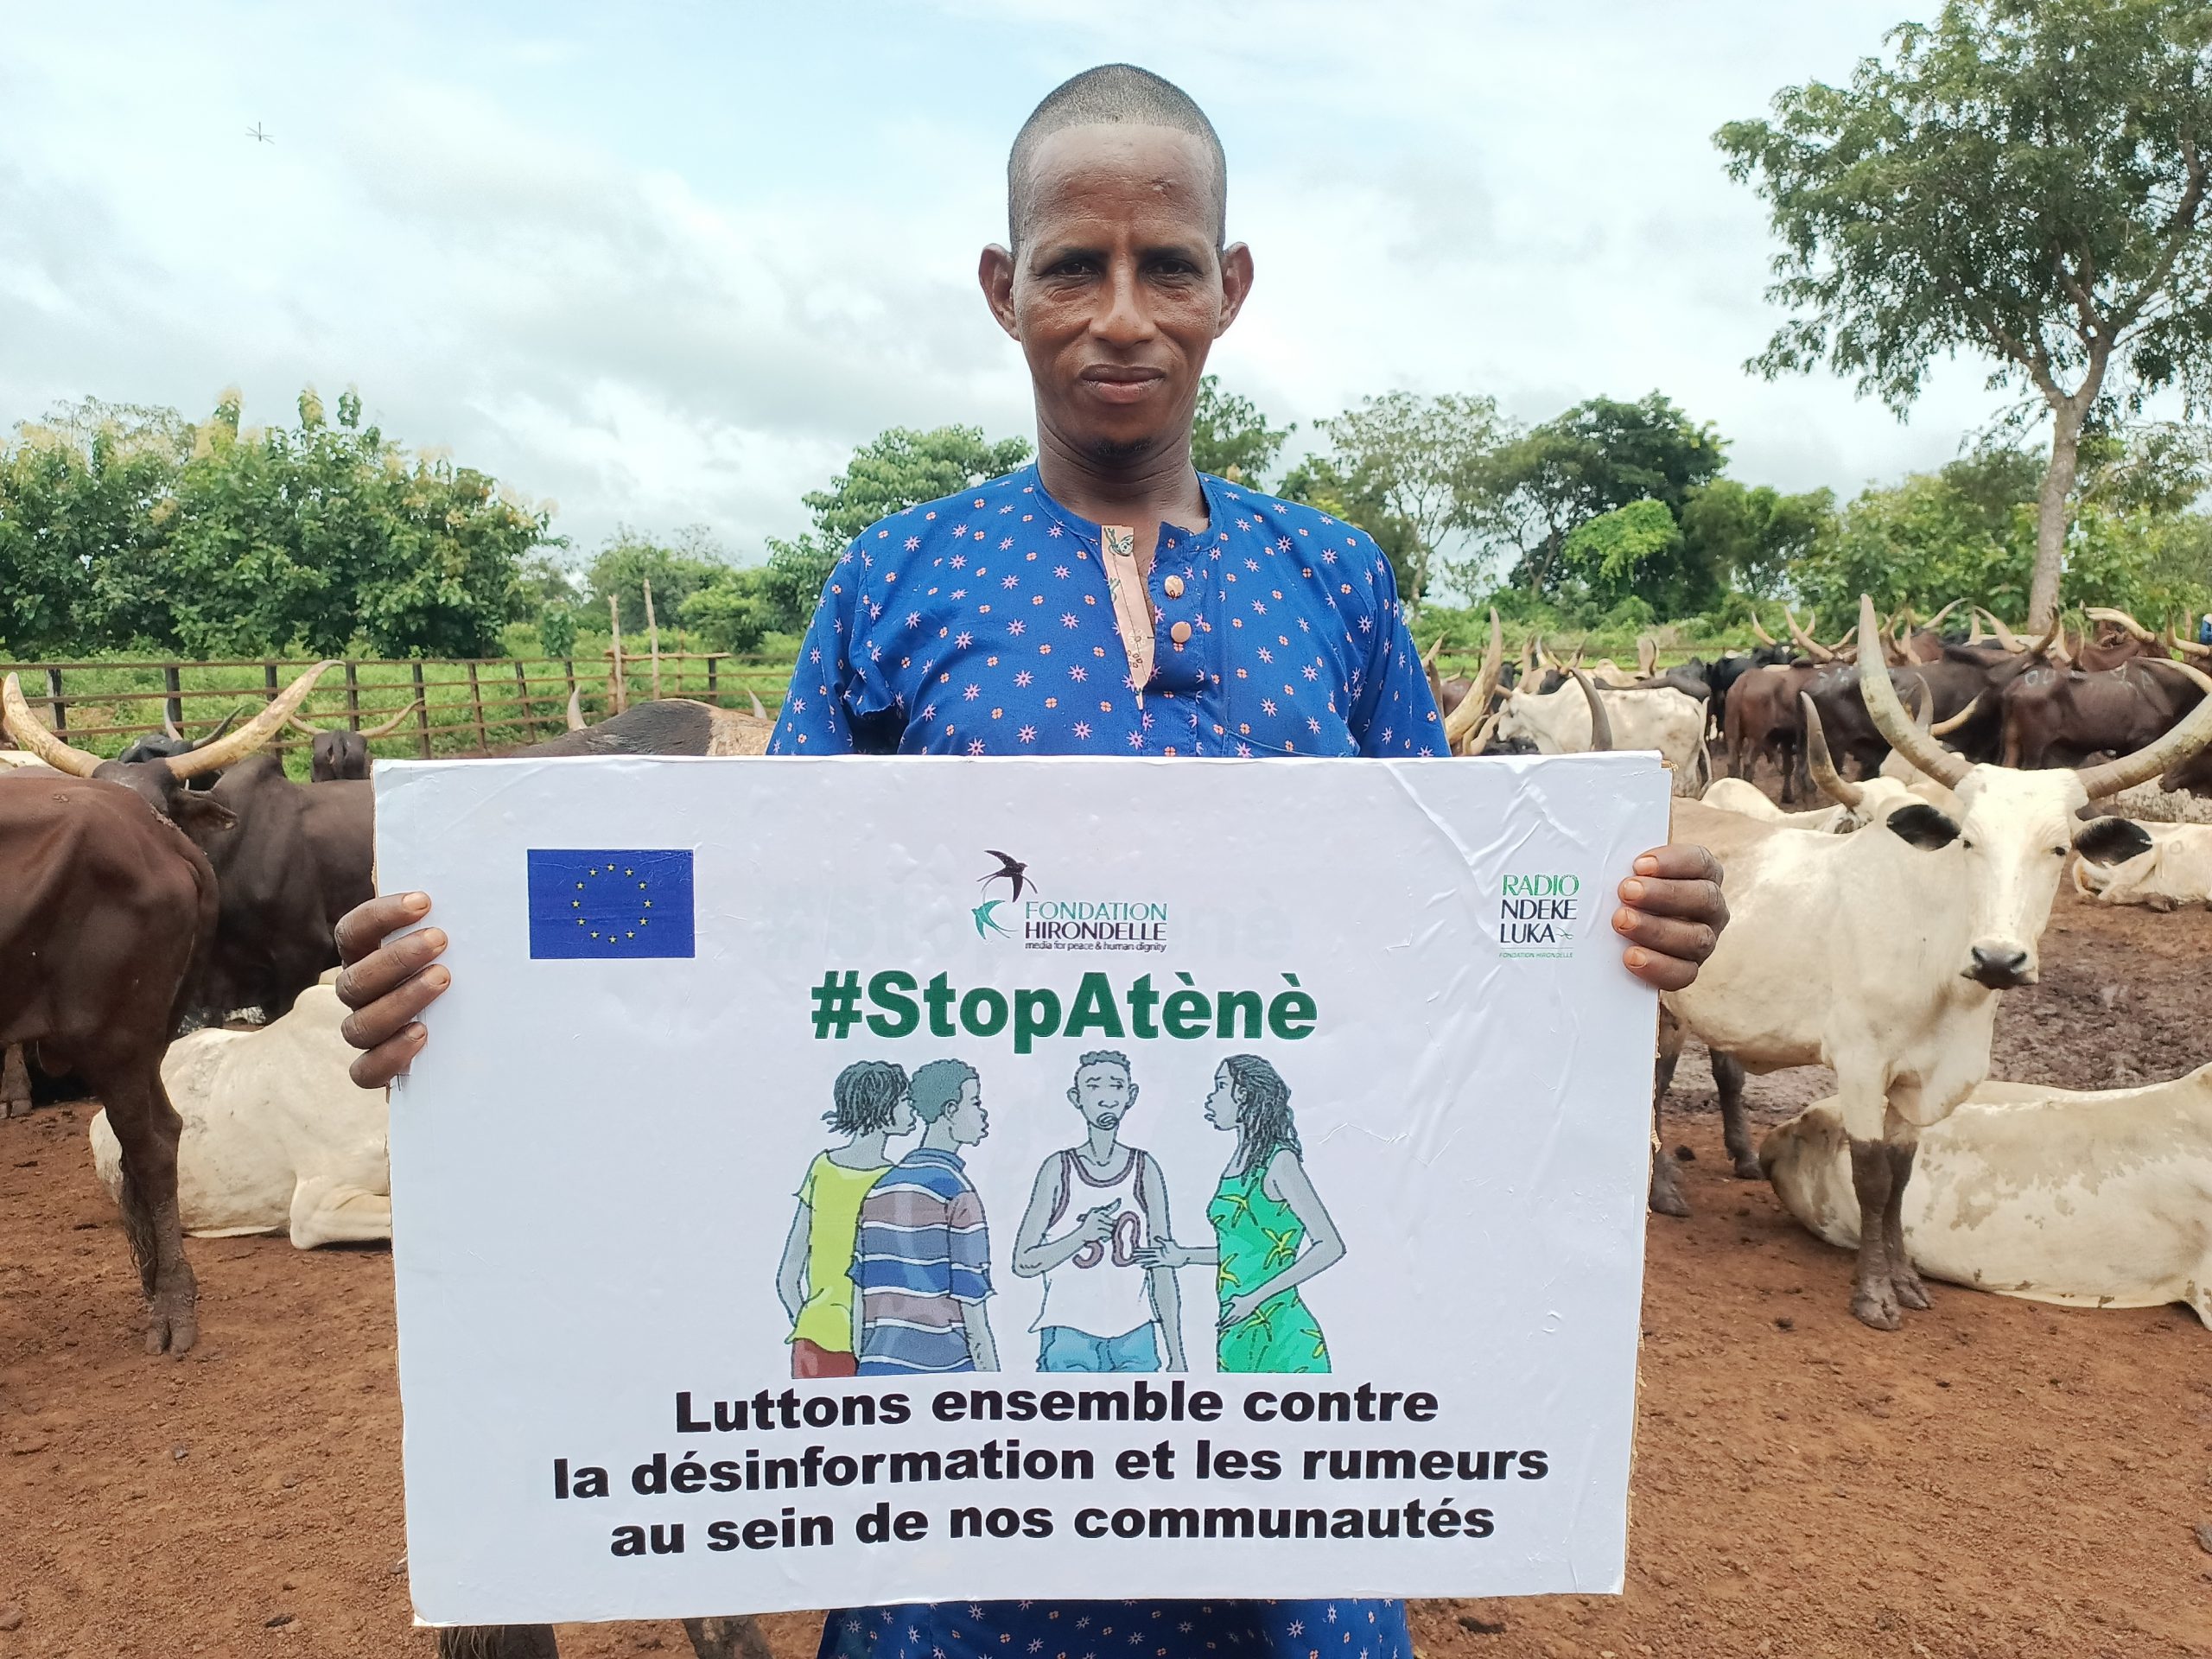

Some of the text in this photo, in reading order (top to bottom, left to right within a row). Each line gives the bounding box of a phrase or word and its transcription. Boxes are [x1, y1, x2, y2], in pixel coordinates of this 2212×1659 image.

[1502, 874, 1580, 897] RADIO
[1025, 900, 1167, 921] FONDATION
[1501, 899, 1578, 920] NDEKE
[1025, 921, 1167, 941] HIRONDELLE
[1500, 923, 1556, 944] LUKA
[1025, 941, 1166, 952] media for peace & human dignity
[810, 970, 1318, 1054] #StopAtènè
[676, 1380, 1439, 1433] Luttons ensemble contre
[554, 1439, 1548, 1500] la désinformation et les rumeurs
[610, 1497, 1495, 1557] au sein de nos communautés
